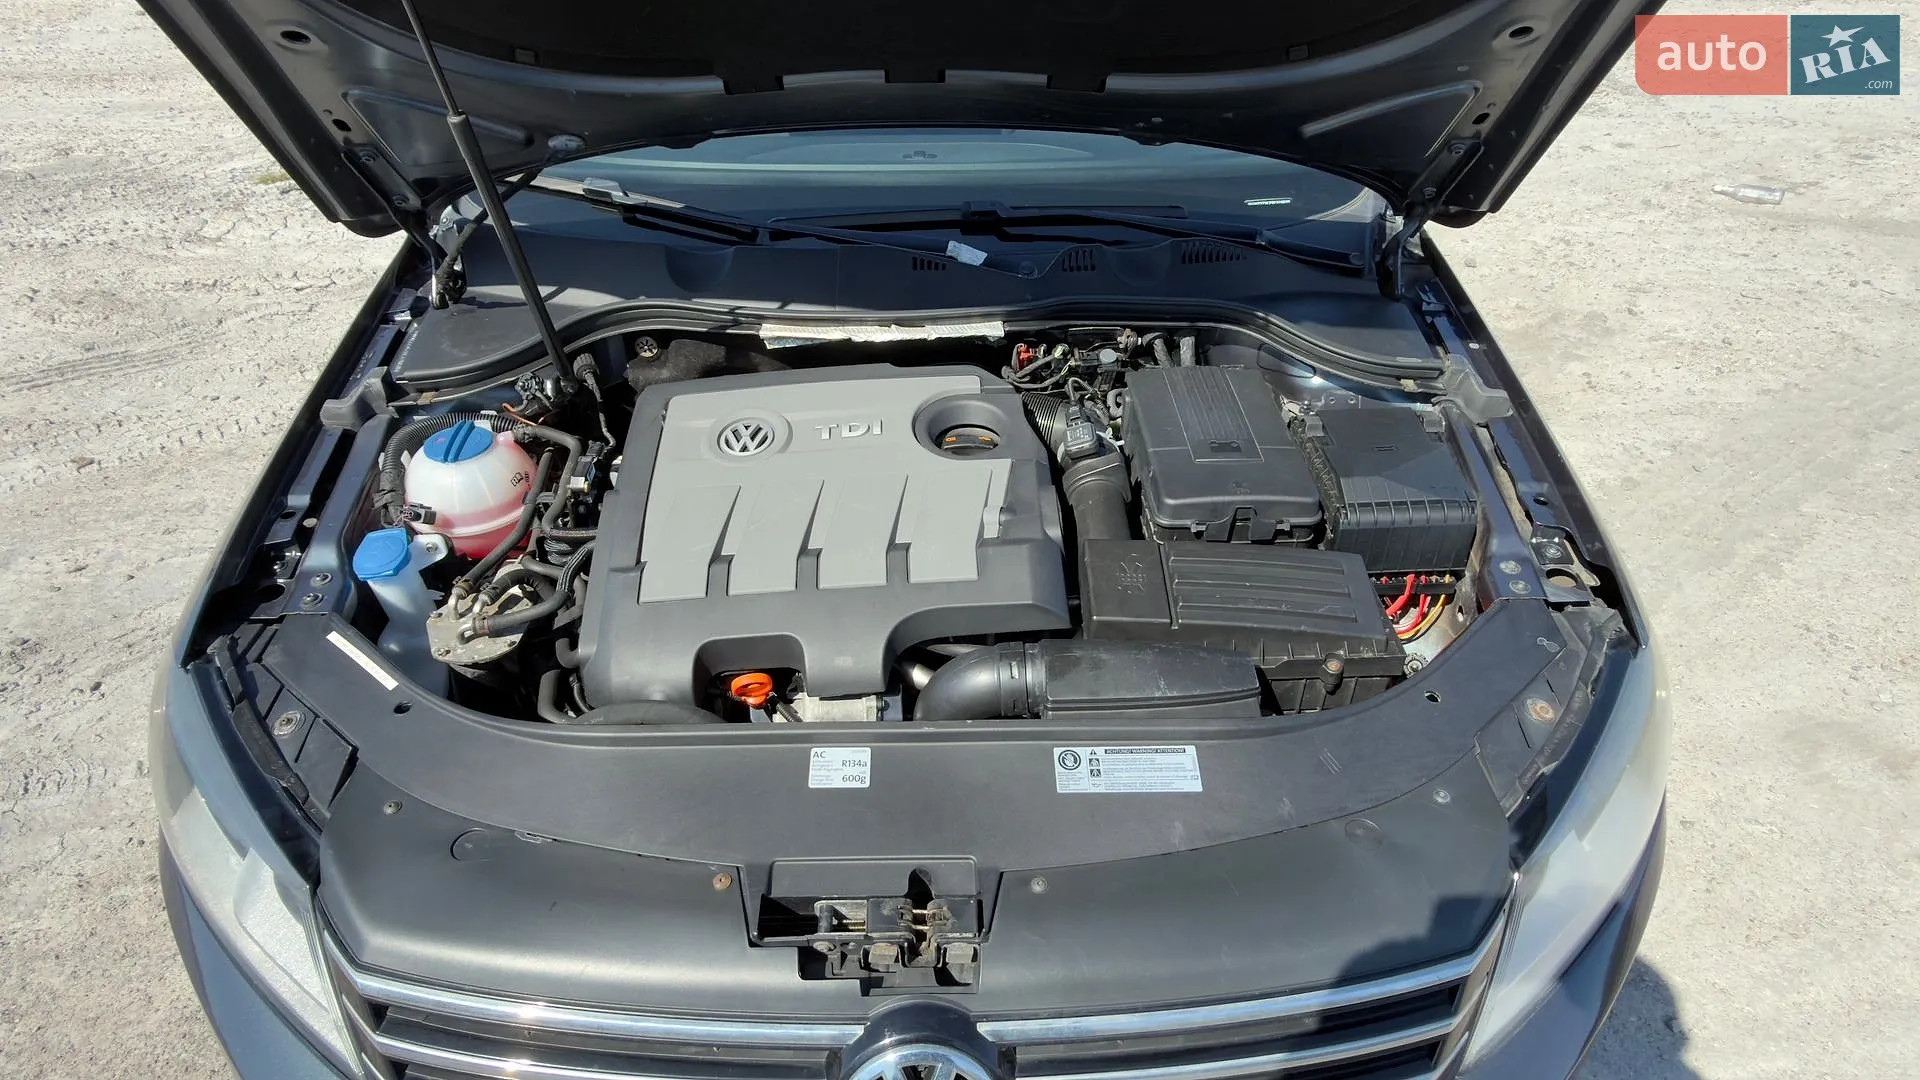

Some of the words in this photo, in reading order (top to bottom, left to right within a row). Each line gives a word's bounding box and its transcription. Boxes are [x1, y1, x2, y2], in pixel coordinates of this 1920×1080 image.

[814, 418, 883, 440] TDI
[812, 751, 827, 759] AC
[841, 759, 868, 768] R134a
[841, 774, 867, 784] 600g
